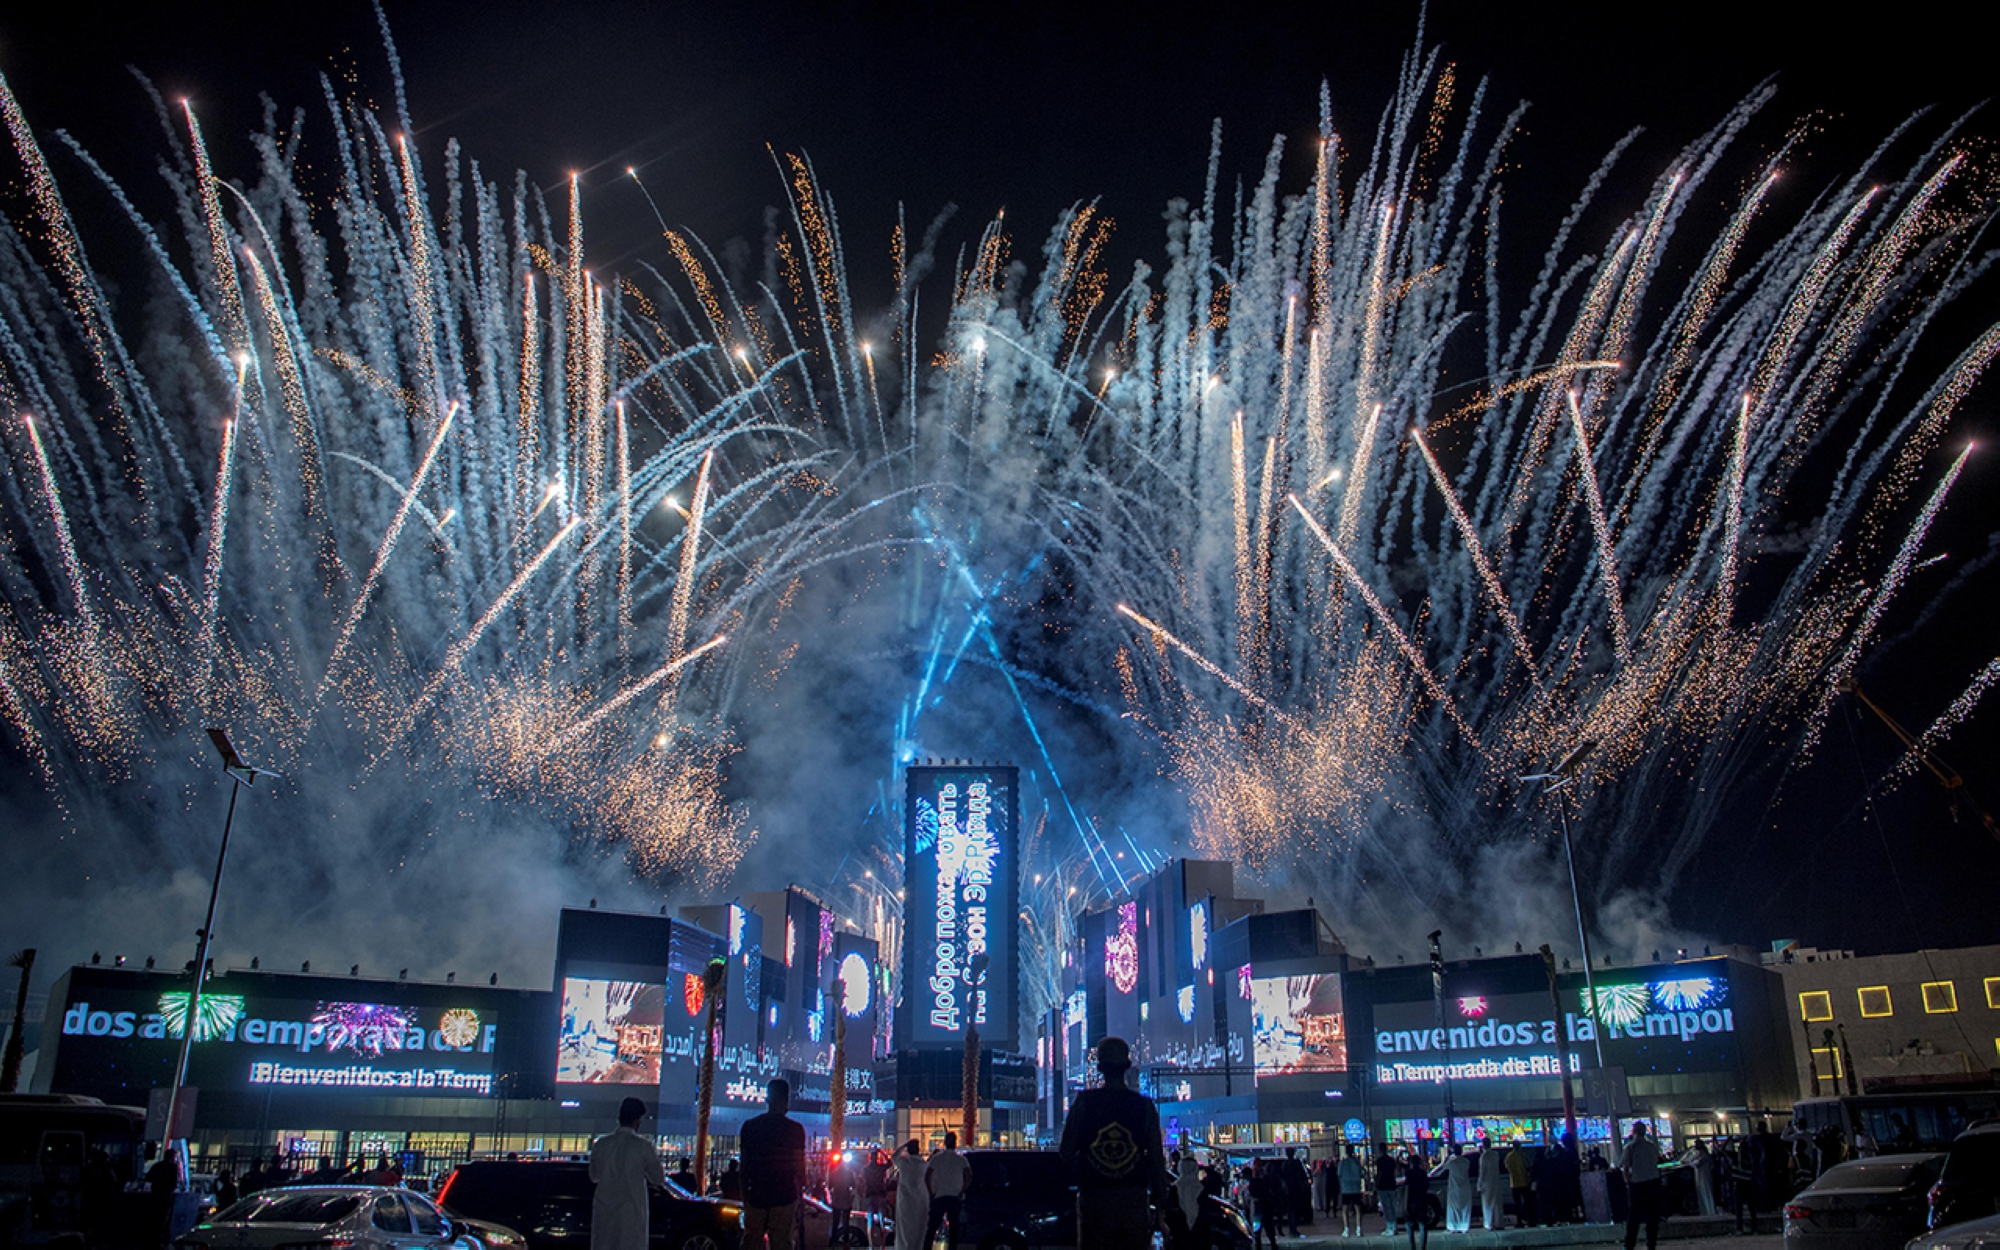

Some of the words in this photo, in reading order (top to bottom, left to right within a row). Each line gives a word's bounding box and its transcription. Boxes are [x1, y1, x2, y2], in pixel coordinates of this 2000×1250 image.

[937, 782, 958, 937] пожаовать
[962, 907, 986, 986] Сзон
[930, 941, 960, 1031] Добро
[1374, 1018, 1540, 1054] envenidos
[1565, 1012, 1595, 1042] la
[251, 1063, 396, 1087] Bienvenidos
[1393, 1058, 1501, 1084] Temporada
